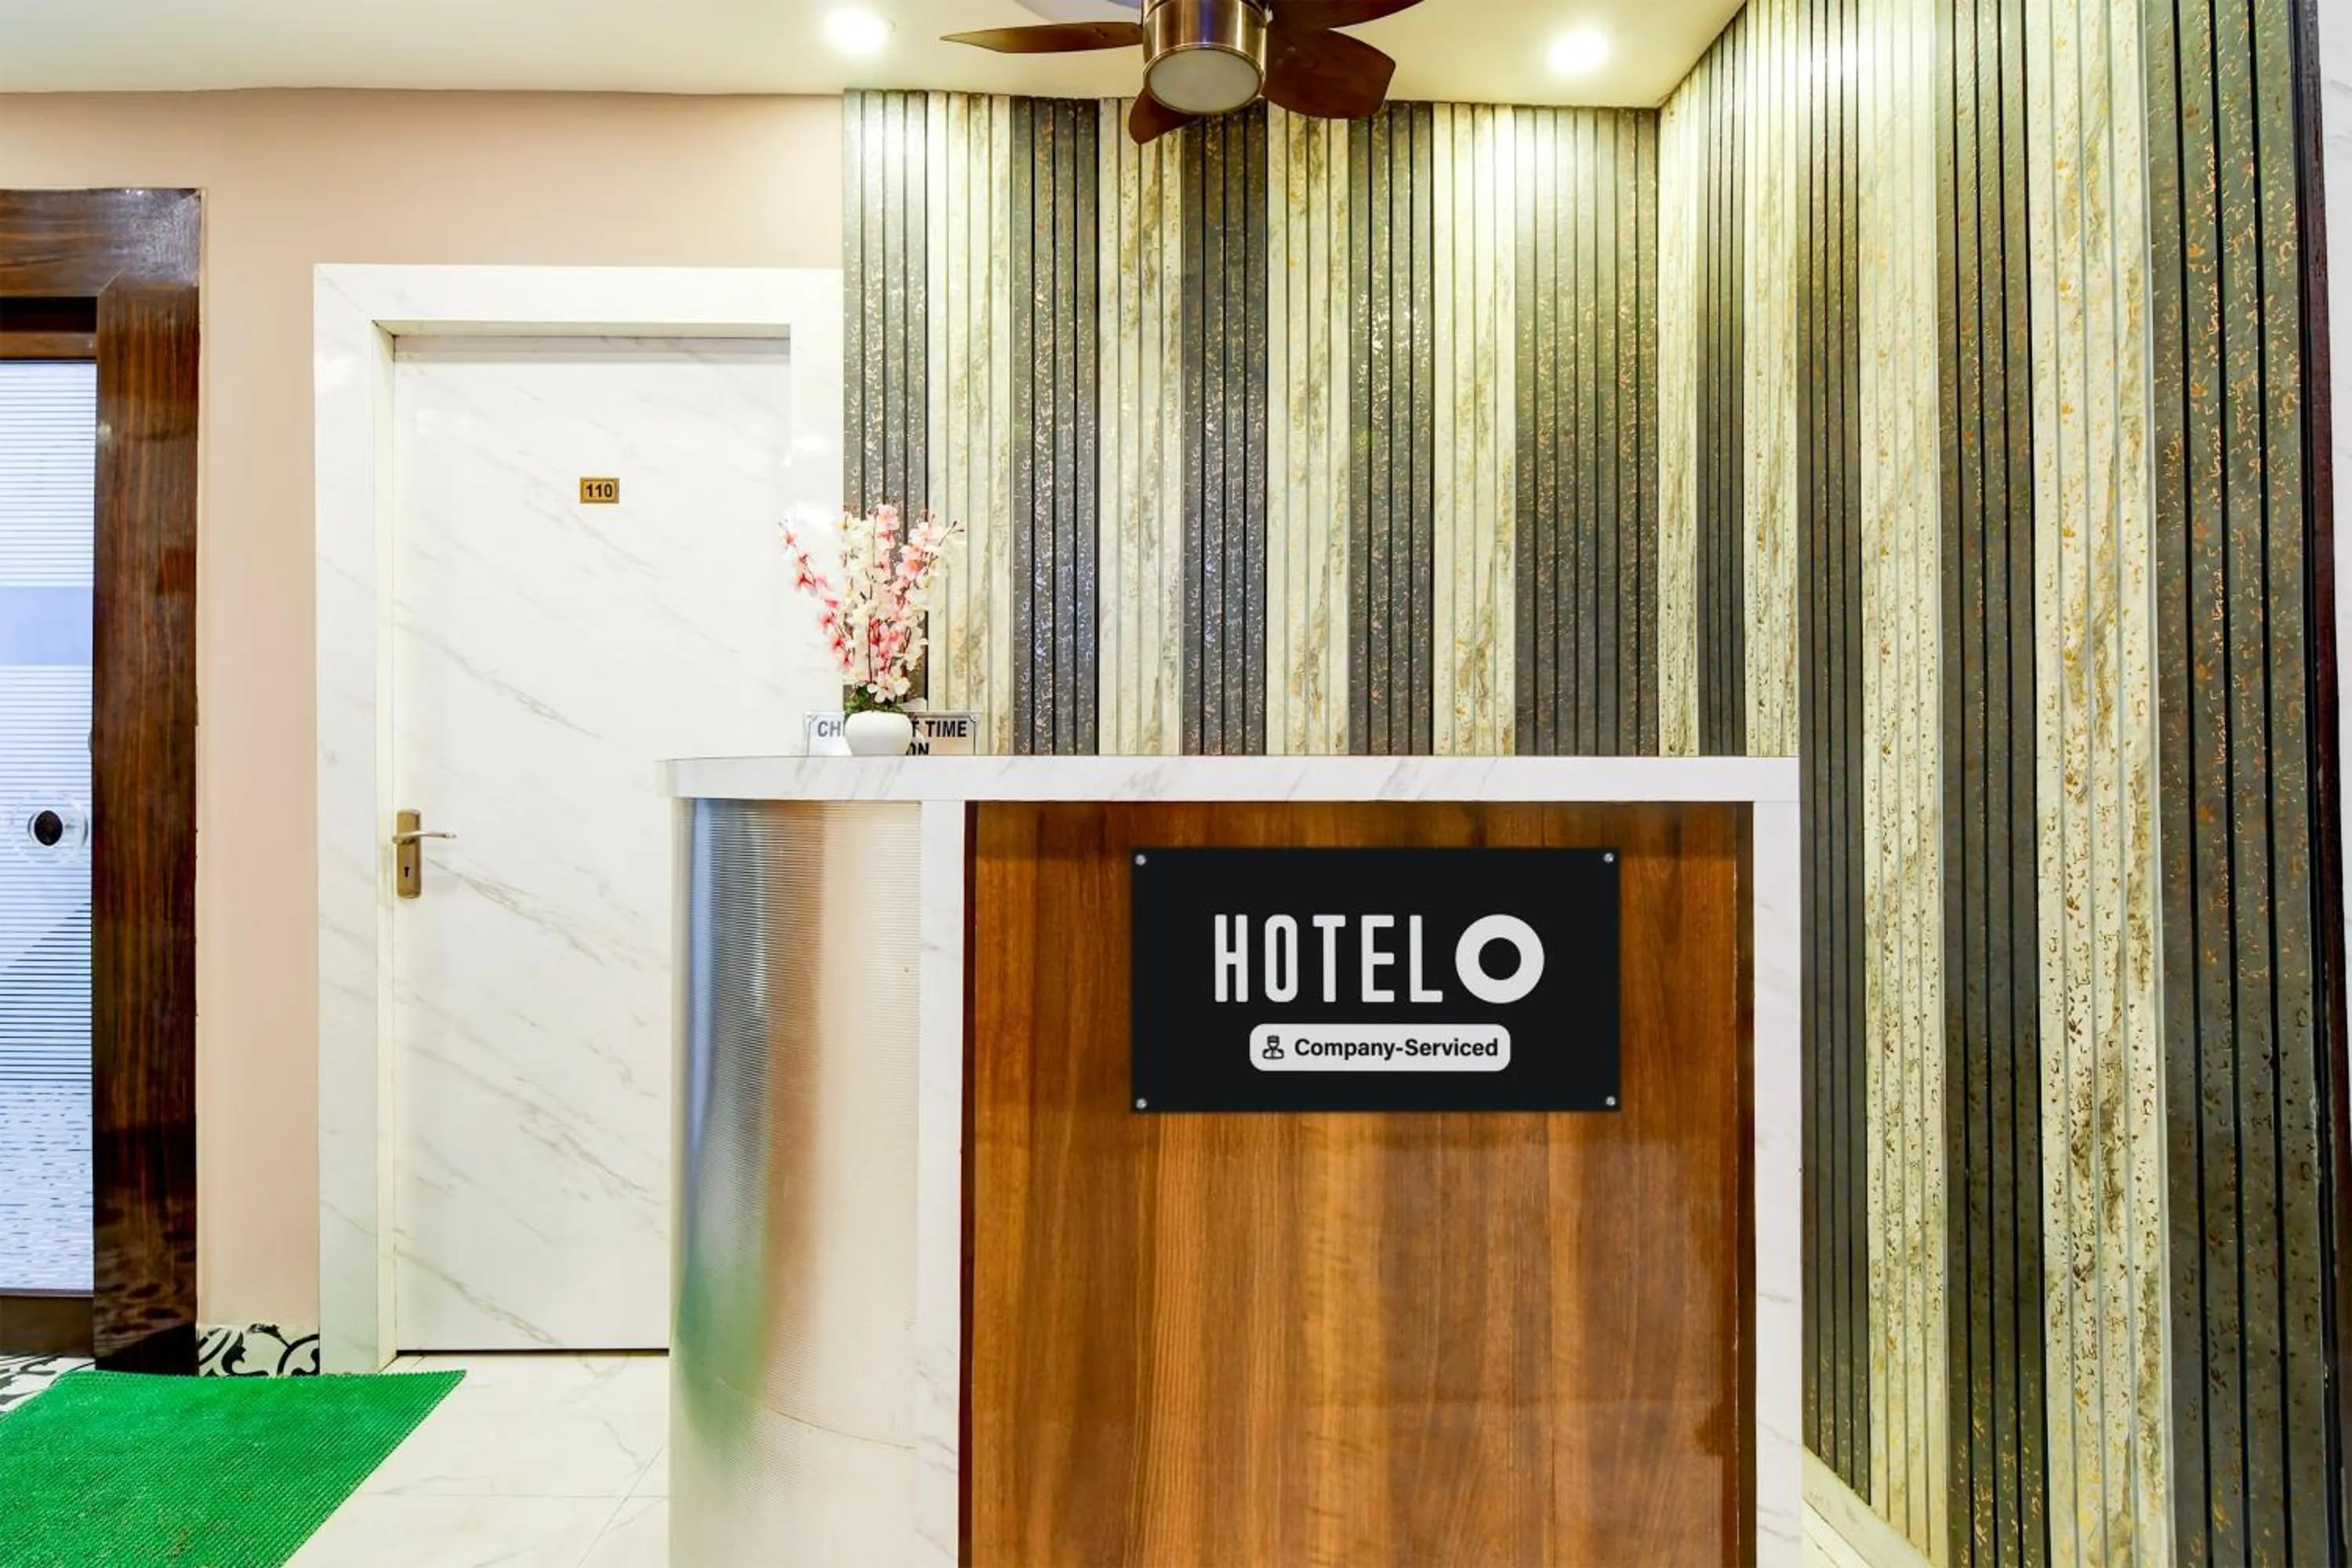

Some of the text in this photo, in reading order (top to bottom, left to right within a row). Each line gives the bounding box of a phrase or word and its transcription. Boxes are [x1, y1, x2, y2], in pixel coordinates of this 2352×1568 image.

[586, 483, 613, 498] 110
[818, 720, 846, 738] CH
[924, 720, 967, 738] TIME
[1214, 914, 1443, 1003] HOTEL
[1294, 1037, 1499, 1062] Company-Serviced
